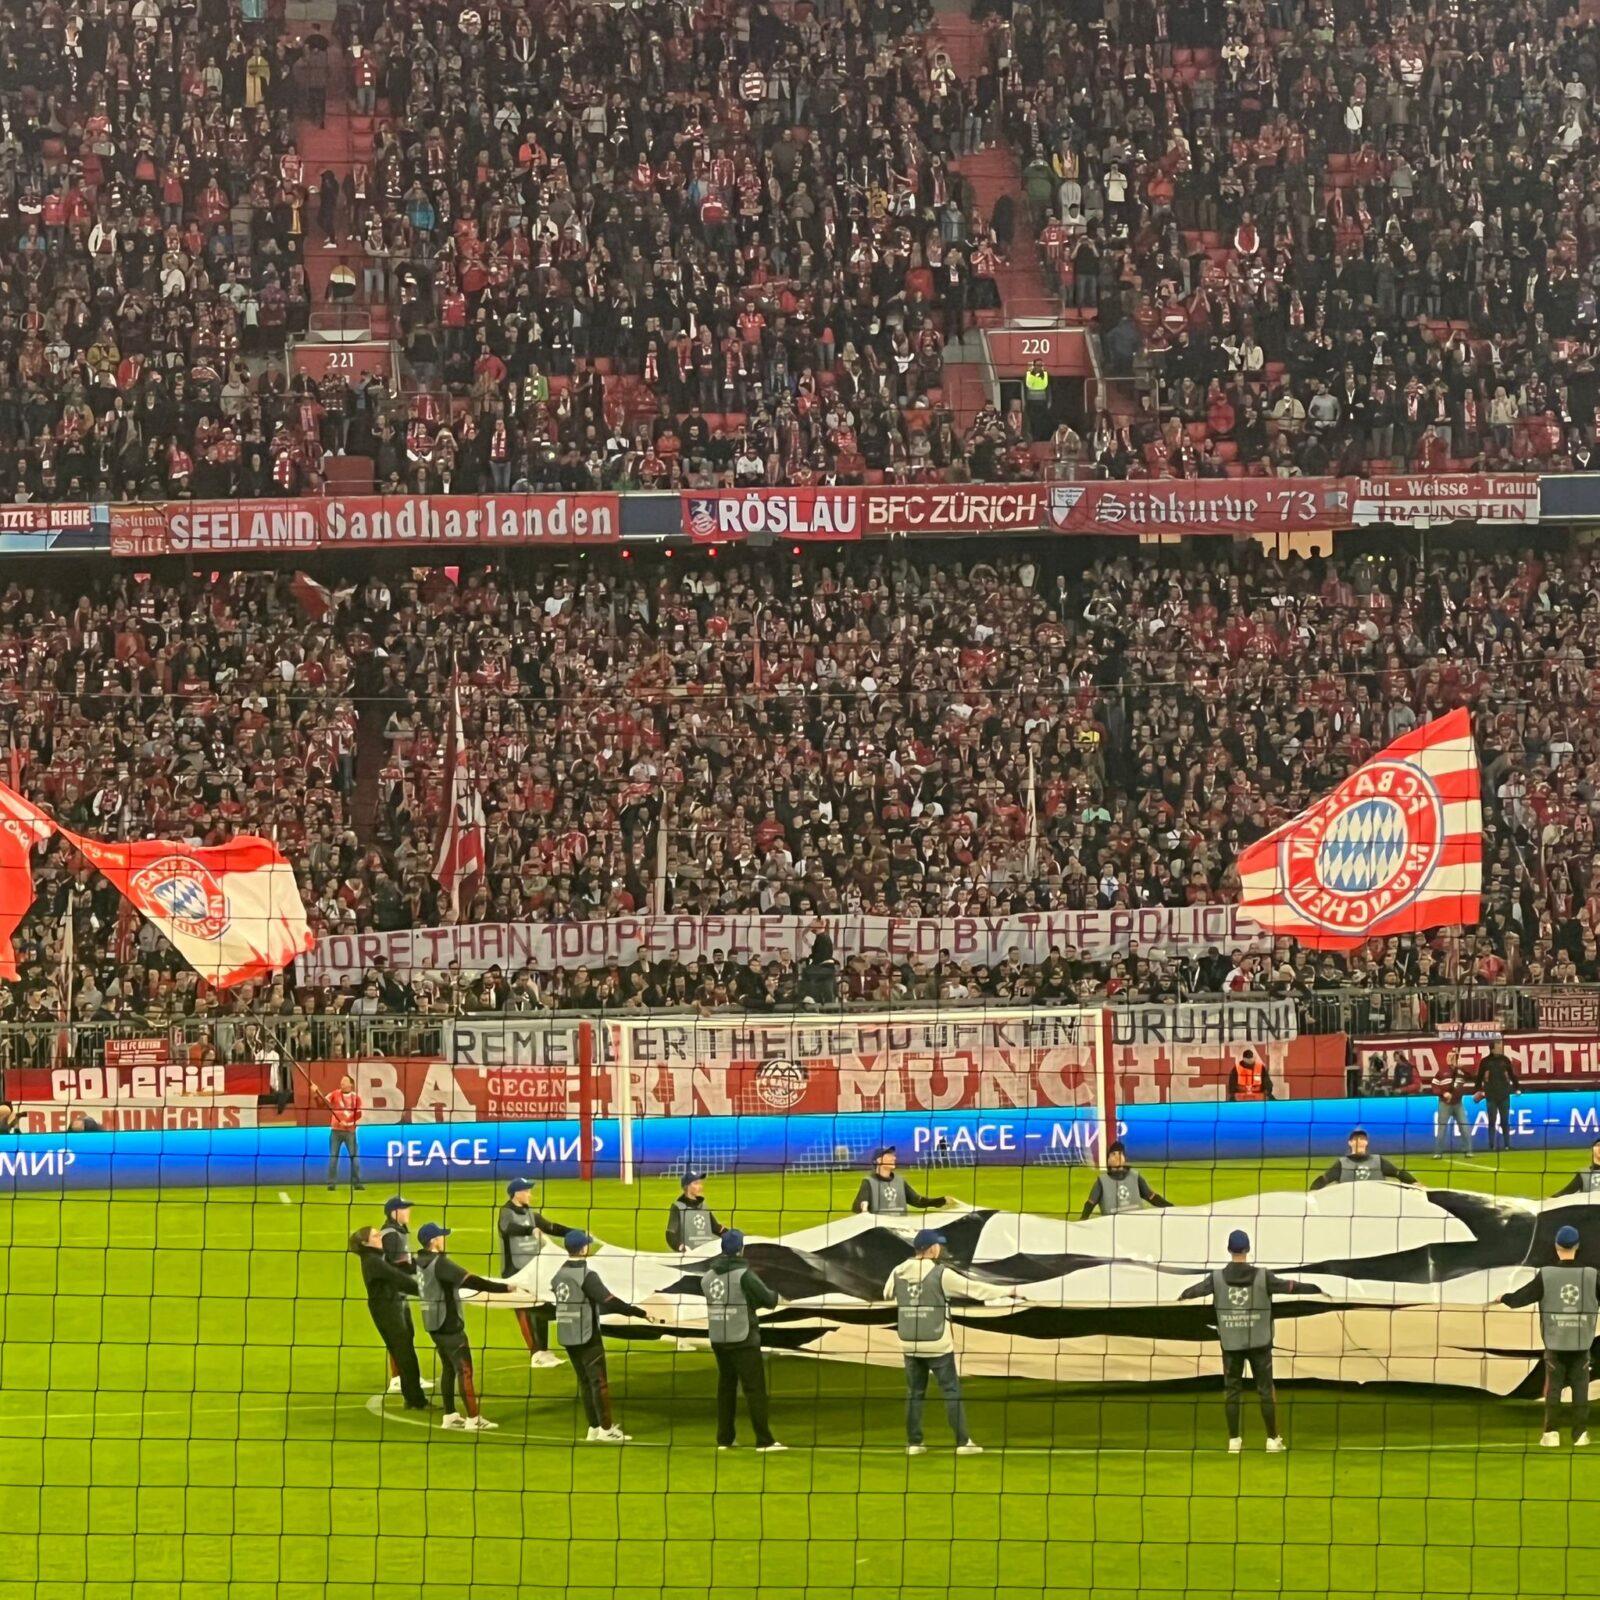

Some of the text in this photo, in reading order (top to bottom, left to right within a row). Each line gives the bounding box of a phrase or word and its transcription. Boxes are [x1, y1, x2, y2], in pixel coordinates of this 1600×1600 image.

[328, 351, 354, 368] 221
[1021, 338, 1050, 355] 220
[1408, 479, 1468, 496] Weisse
[1485, 478, 1538, 495] Traun
[0, 508, 91, 529] TZTE REIHE
[326, 498, 612, 539] Sandharlanden
[718, 493, 857, 533] RÖSLAU
[868, 491, 1037, 525] BFC ZÜRICH
[1095, 490, 1317, 524] Südkurve '73
[170, 510, 315, 550] SEELAND
[541, 921, 609, 960] 100
[615, 913, 786, 952] PEOPLE
[953, 917, 1009, 953] BY
[1017, 912, 1100, 950] THE
[1109, 906, 1253, 945] POLICE
[1538, 1005, 1598, 1021] JUNGS!
[487, 1077, 566, 1097] GEGEN
[487, 1099, 566, 1118] RASSISMUS
[913, 1123, 1017, 1152] PEACE
[387, 1138, 491, 1168] PEACE
